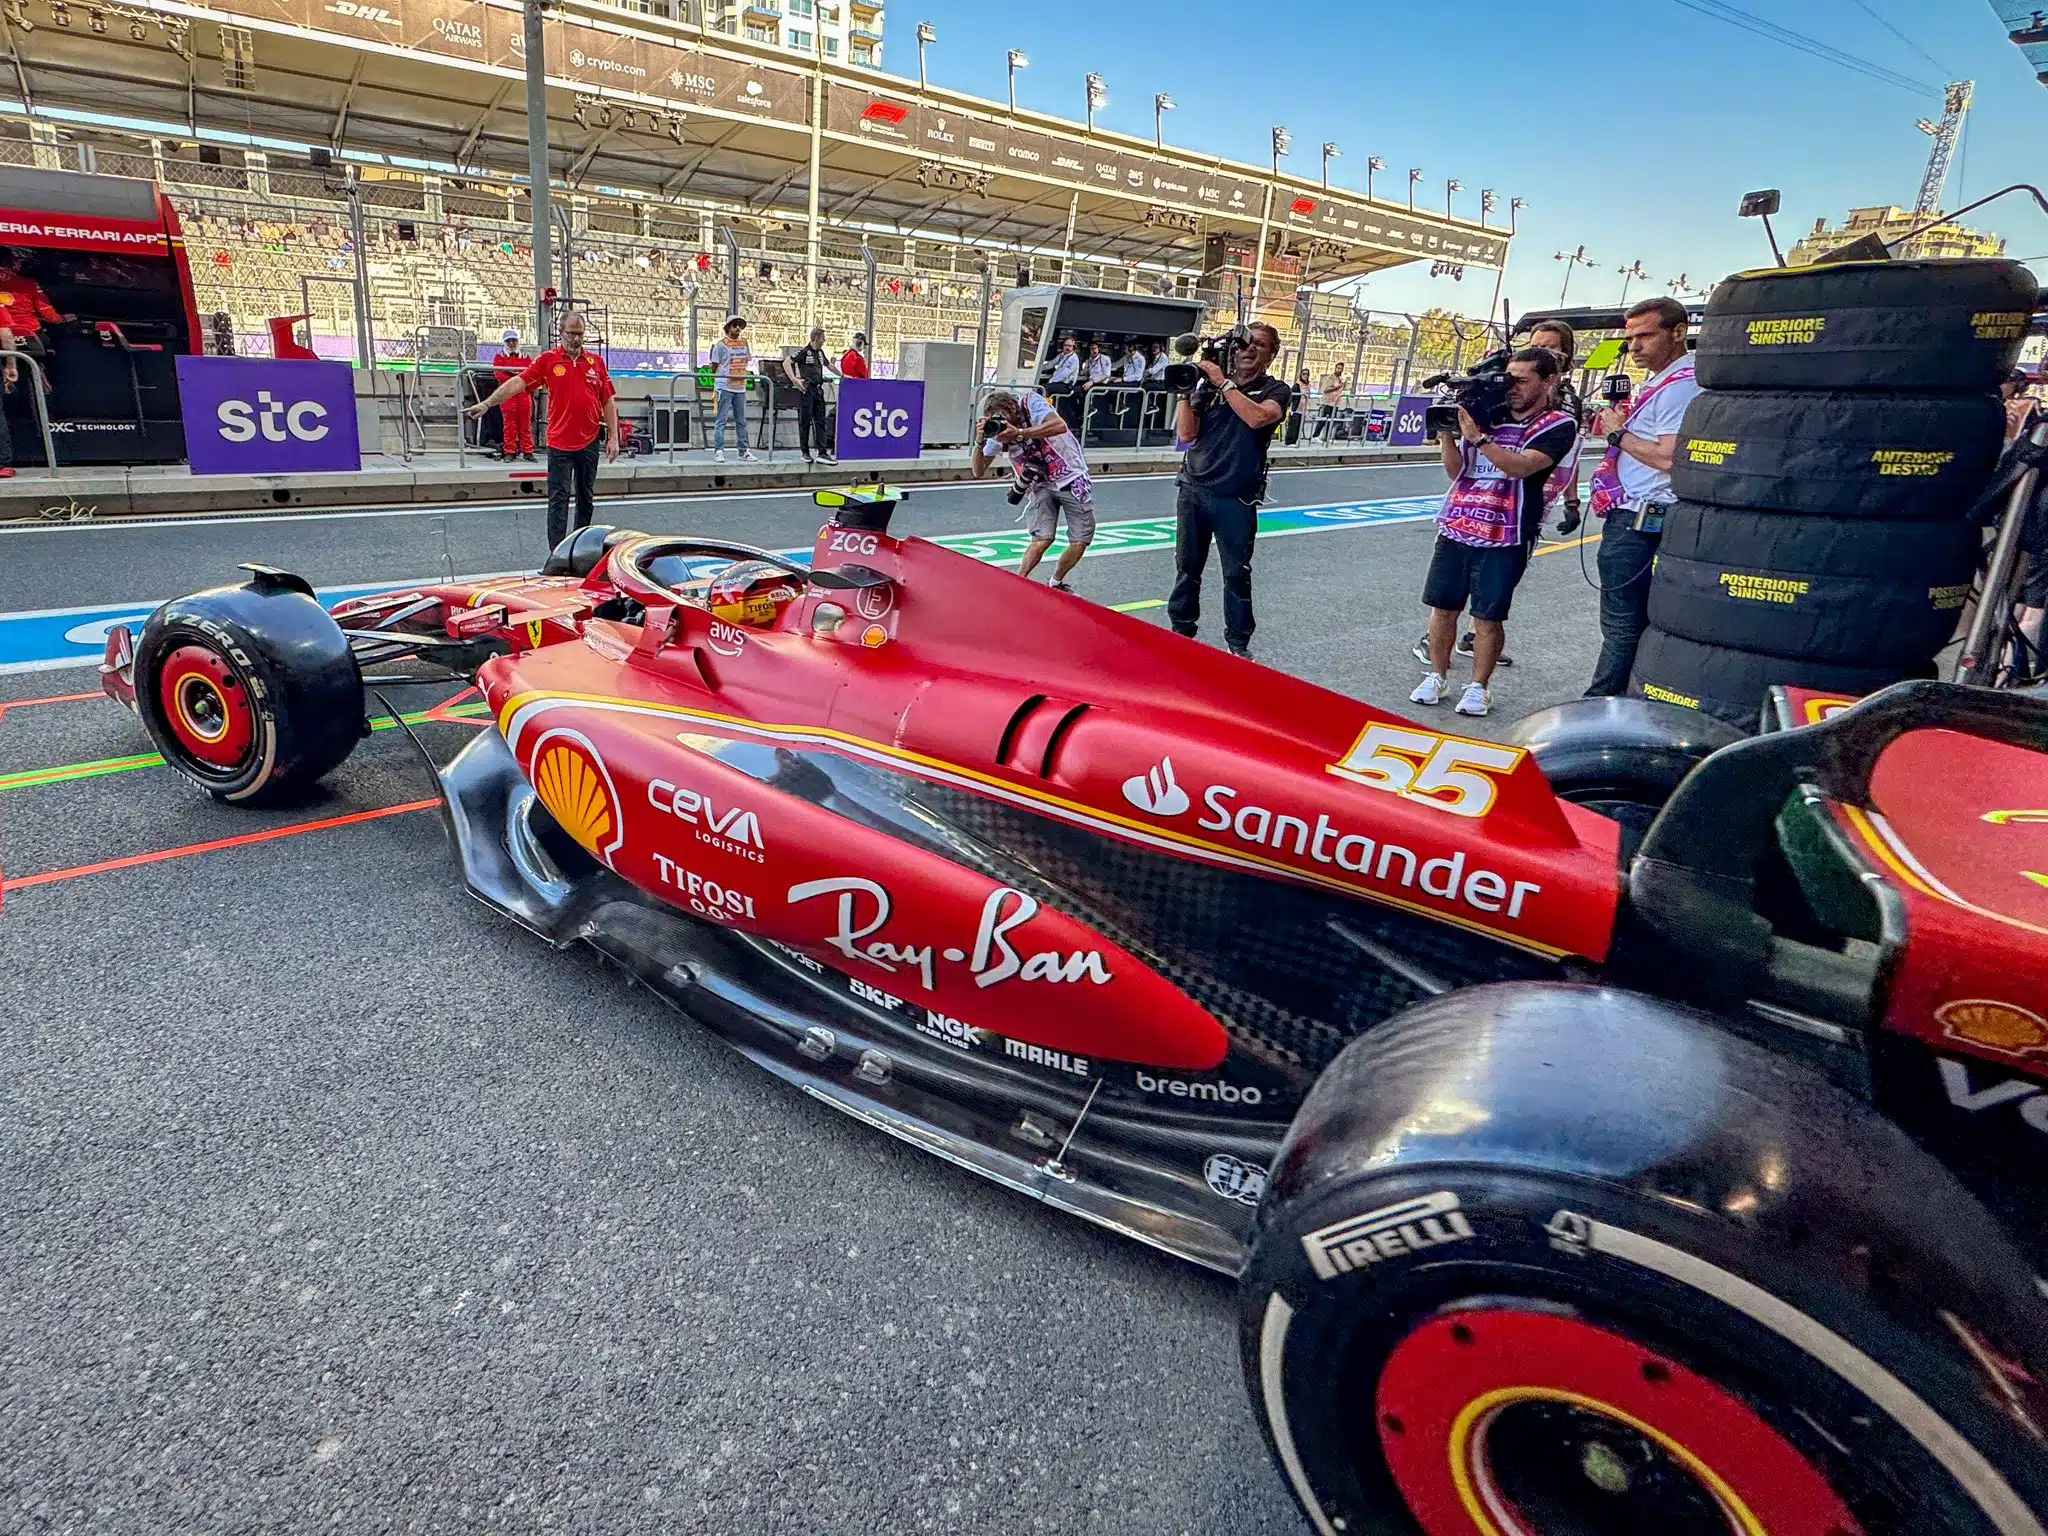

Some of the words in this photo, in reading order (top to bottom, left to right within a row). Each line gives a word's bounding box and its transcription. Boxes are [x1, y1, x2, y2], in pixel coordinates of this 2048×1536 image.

[328, 1, 400, 25] DHL
[432, 18, 480, 38] QATAR
[445, 33, 483, 48] AIRWAYS
[587, 56, 646, 77] crypto.com
[685, 72, 715, 90] MSC
[736, 94, 772, 108] salesforce
[927, 129, 955, 143] ROLEX
[1009, 147, 1040, 161] aramco
[1095, 163, 1118, 175] QATAR
[44, 226, 121, 242] FERRARI
[123, 233, 158, 244] APP
[1745, 317, 1825, 335] ANTERIORE
[1748, 330, 1815, 346] SINISTRO
[76, 423, 136, 431] TECHNOLOGY
[217, 391, 330, 443] stc
[852, 401, 909, 438] stc
[1398, 410, 1423, 434] stc
[1687, 439, 1737, 455] ANTERIORE
[1870, 450, 1955, 465] ANTERIORE
[1689, 451, 1724, 465] DESTRO
[1879, 463, 1938, 476] DESTRO
[829, 531, 879, 556] ZCG
[1719, 573, 1809, 595] POSTERIORE
[1727, 585, 1796, 604] SINISTRO
[181, 613, 252, 667] ZERO
[710, 620, 745, 646] aws
[1643, 683, 1699, 710] POSTERIORE
[1325, 721, 1529, 818] 55
[696, 829, 765, 864] LOGISTICS
[1197, 785, 1541, 918] Santander
[652, 852, 756, 919] TIFOSI
[849, 977, 903, 1011] SKF
[926, 1009, 982, 1046] NGK
[942, 1033, 970, 1050] PLUGS
[1004, 1037, 1089, 1077] MAHLE
[1135, 1071, 1263, 1105] brembo
[1301, 1191, 1475, 1281] PIRELLI
